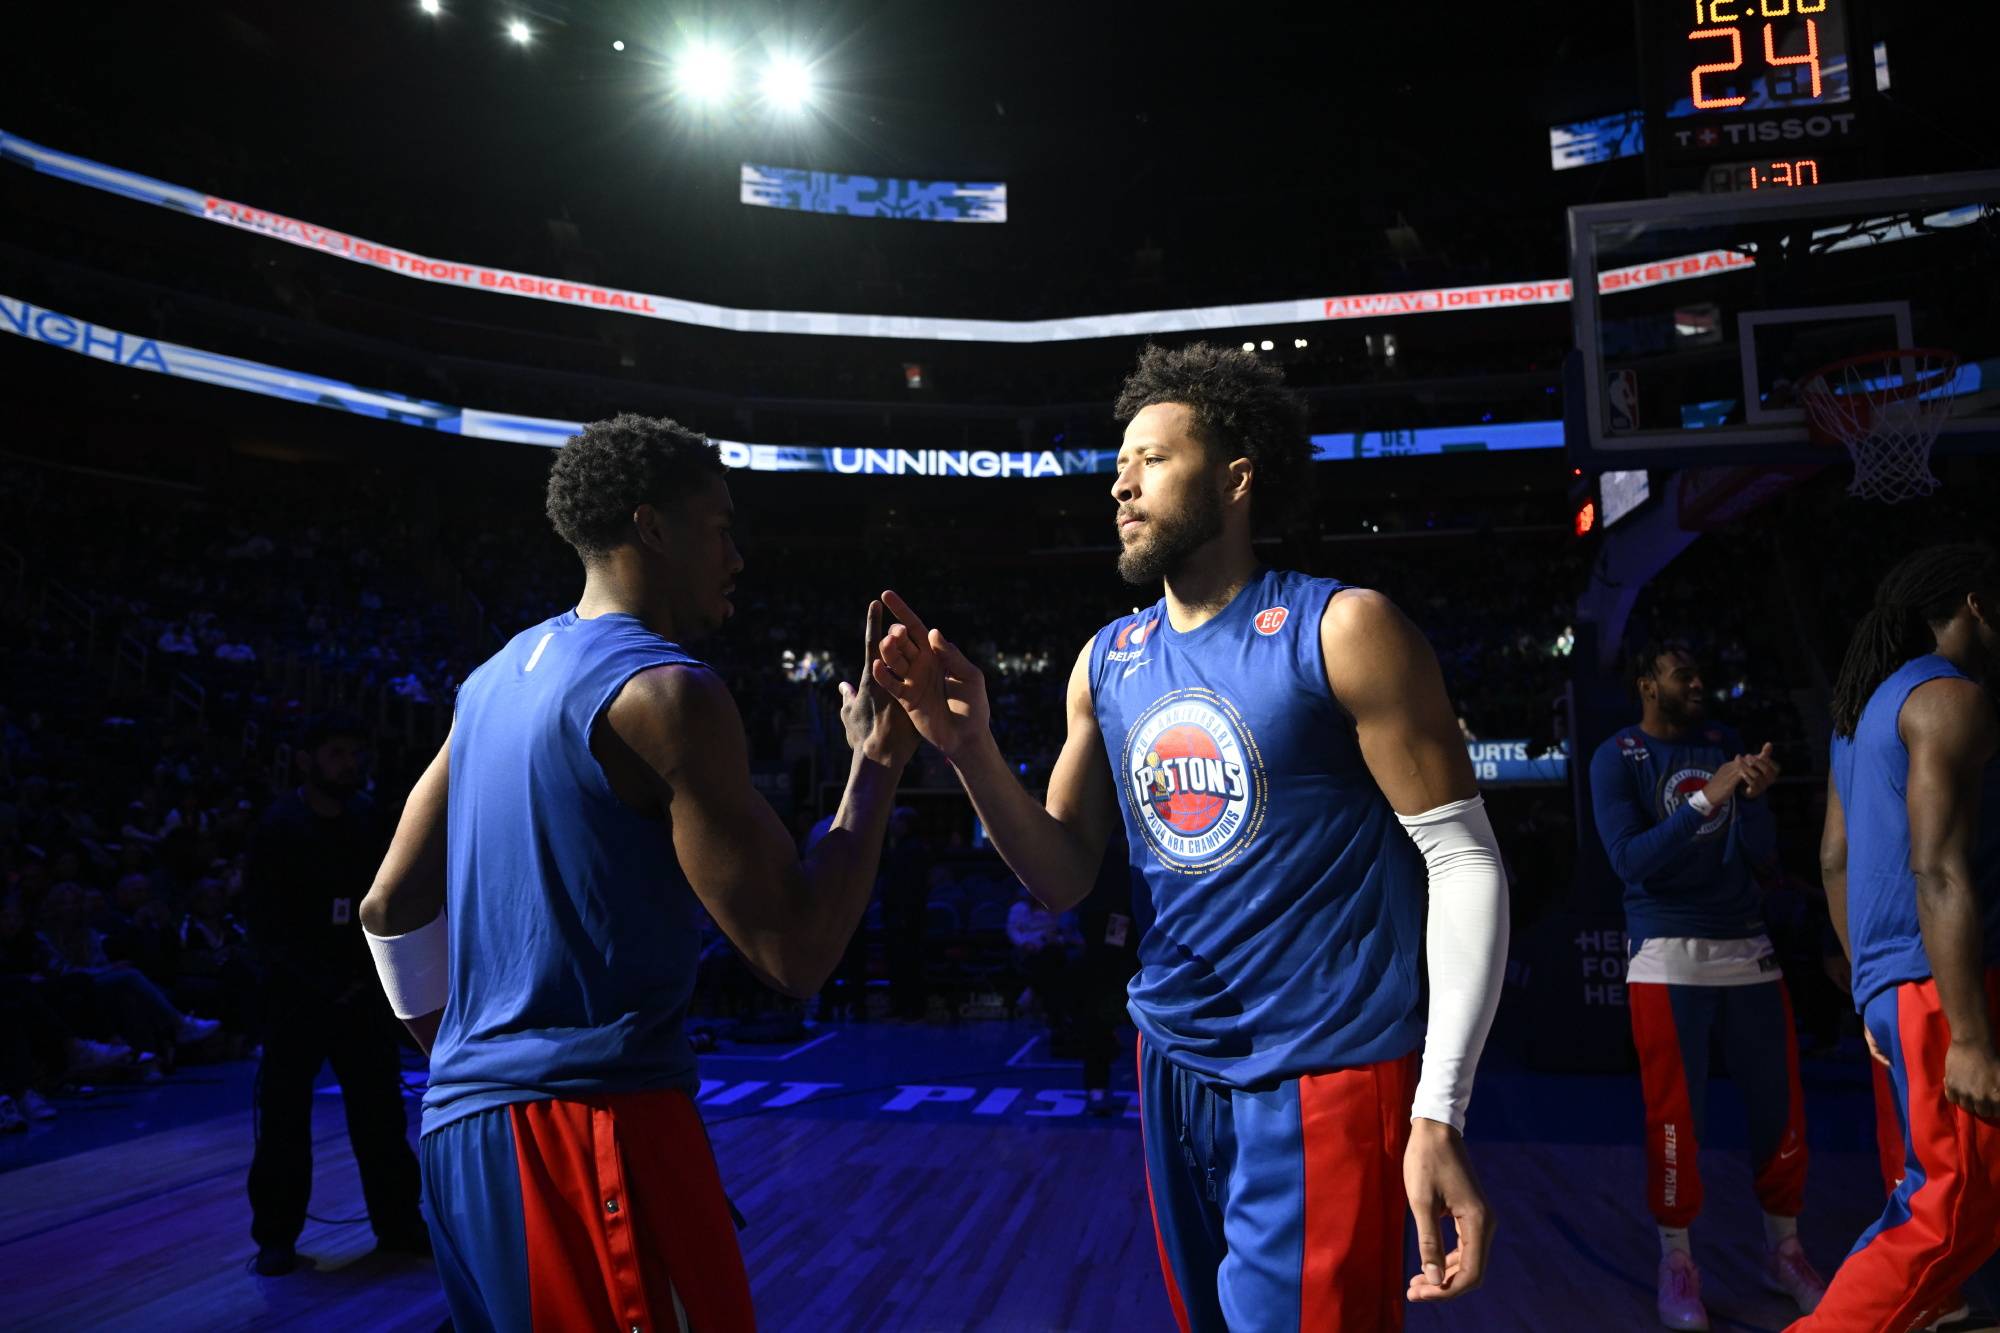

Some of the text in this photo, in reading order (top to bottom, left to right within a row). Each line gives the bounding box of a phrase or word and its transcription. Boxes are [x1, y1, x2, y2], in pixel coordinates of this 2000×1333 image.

[1689, 19, 1821, 108] 24
[1724, 114, 1855, 144] TISSOT
[356, 243, 475, 282] DETROIT
[480, 271, 656, 312] BASKETBALL
[1449, 284, 1560, 306] DETROIT
[1262, 610, 1284, 629] EC
[1147, 809, 1240, 854] 2004 NBA CHAMPIONS
